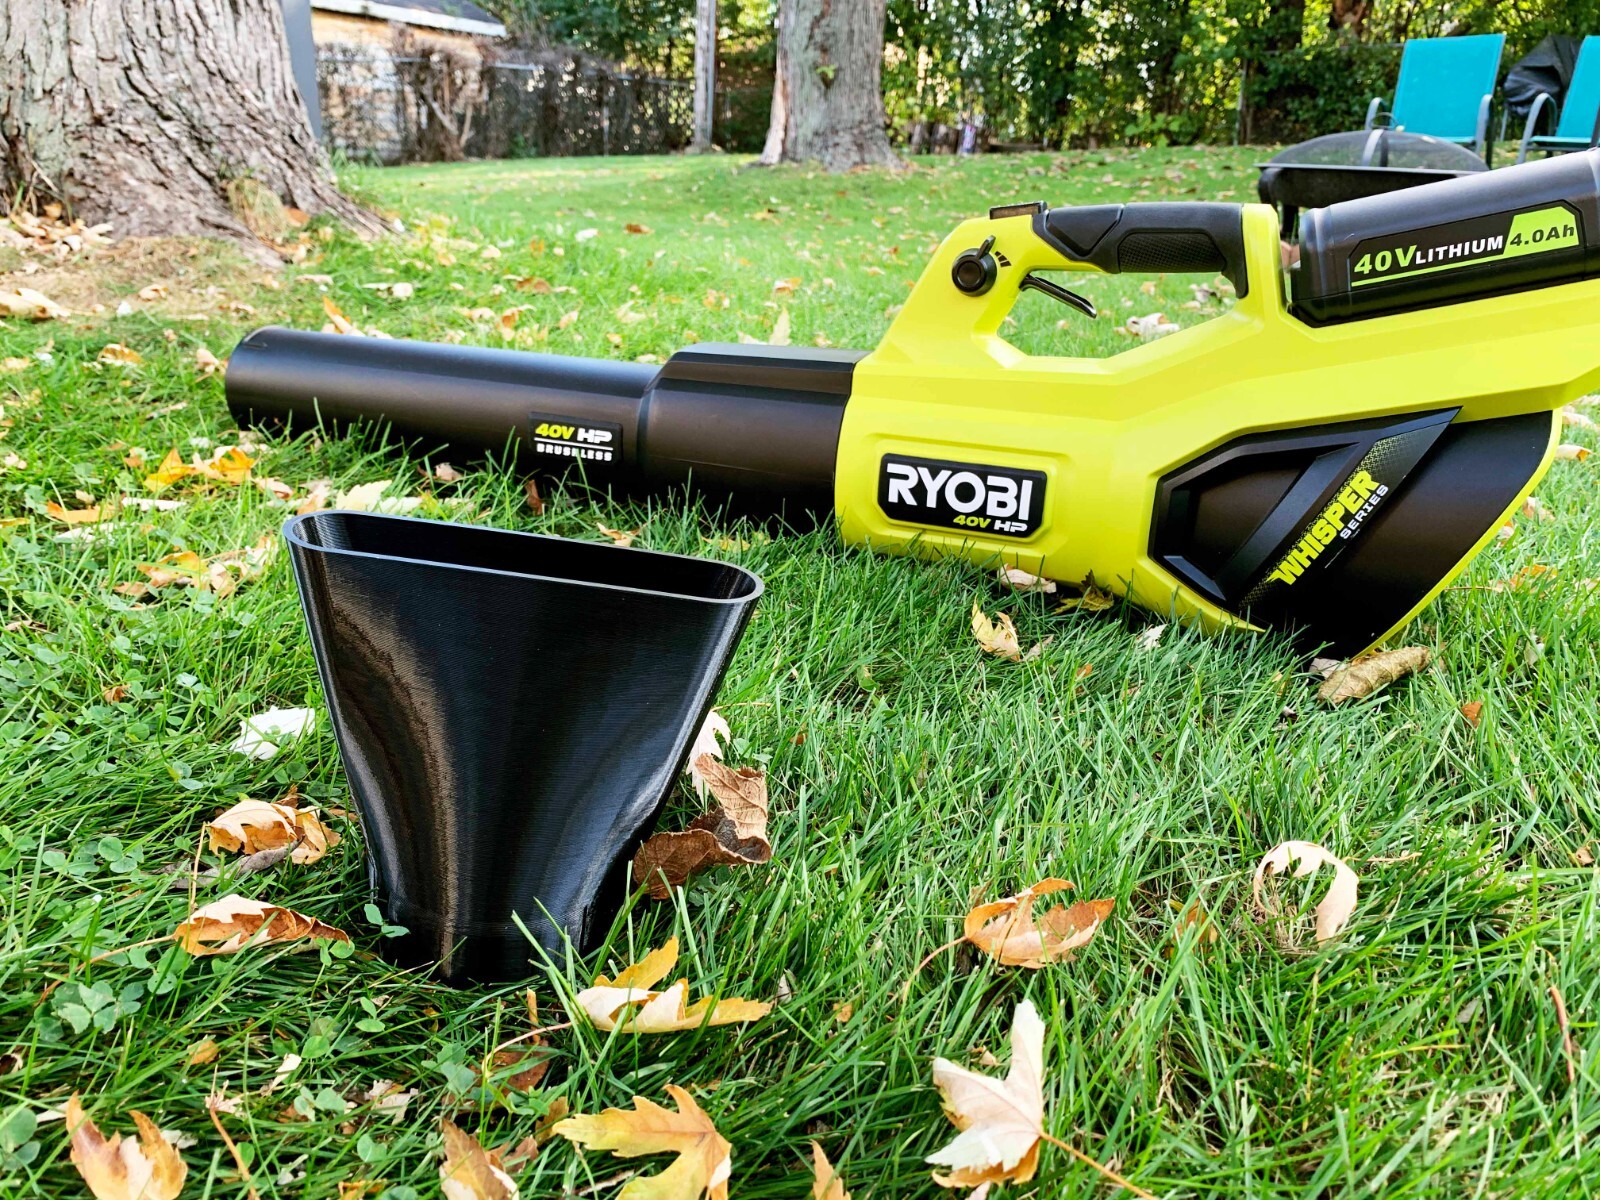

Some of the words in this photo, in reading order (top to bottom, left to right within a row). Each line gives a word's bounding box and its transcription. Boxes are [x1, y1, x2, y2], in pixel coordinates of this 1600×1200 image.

[1354, 245, 1417, 275] 40V
[1415, 235, 1503, 265] LITHIUM
[1509, 224, 1575, 247] 4.0Ah
[535, 423, 575, 440] 40V
[576, 427, 613, 444] HP
[886, 462, 1033, 521] RYOBI
[1339, 484, 1389, 540] SERIES
[953, 515, 991, 529] 40V
[993, 521, 1028, 533] HP
[1265, 470, 1380, 585] WHISPER
